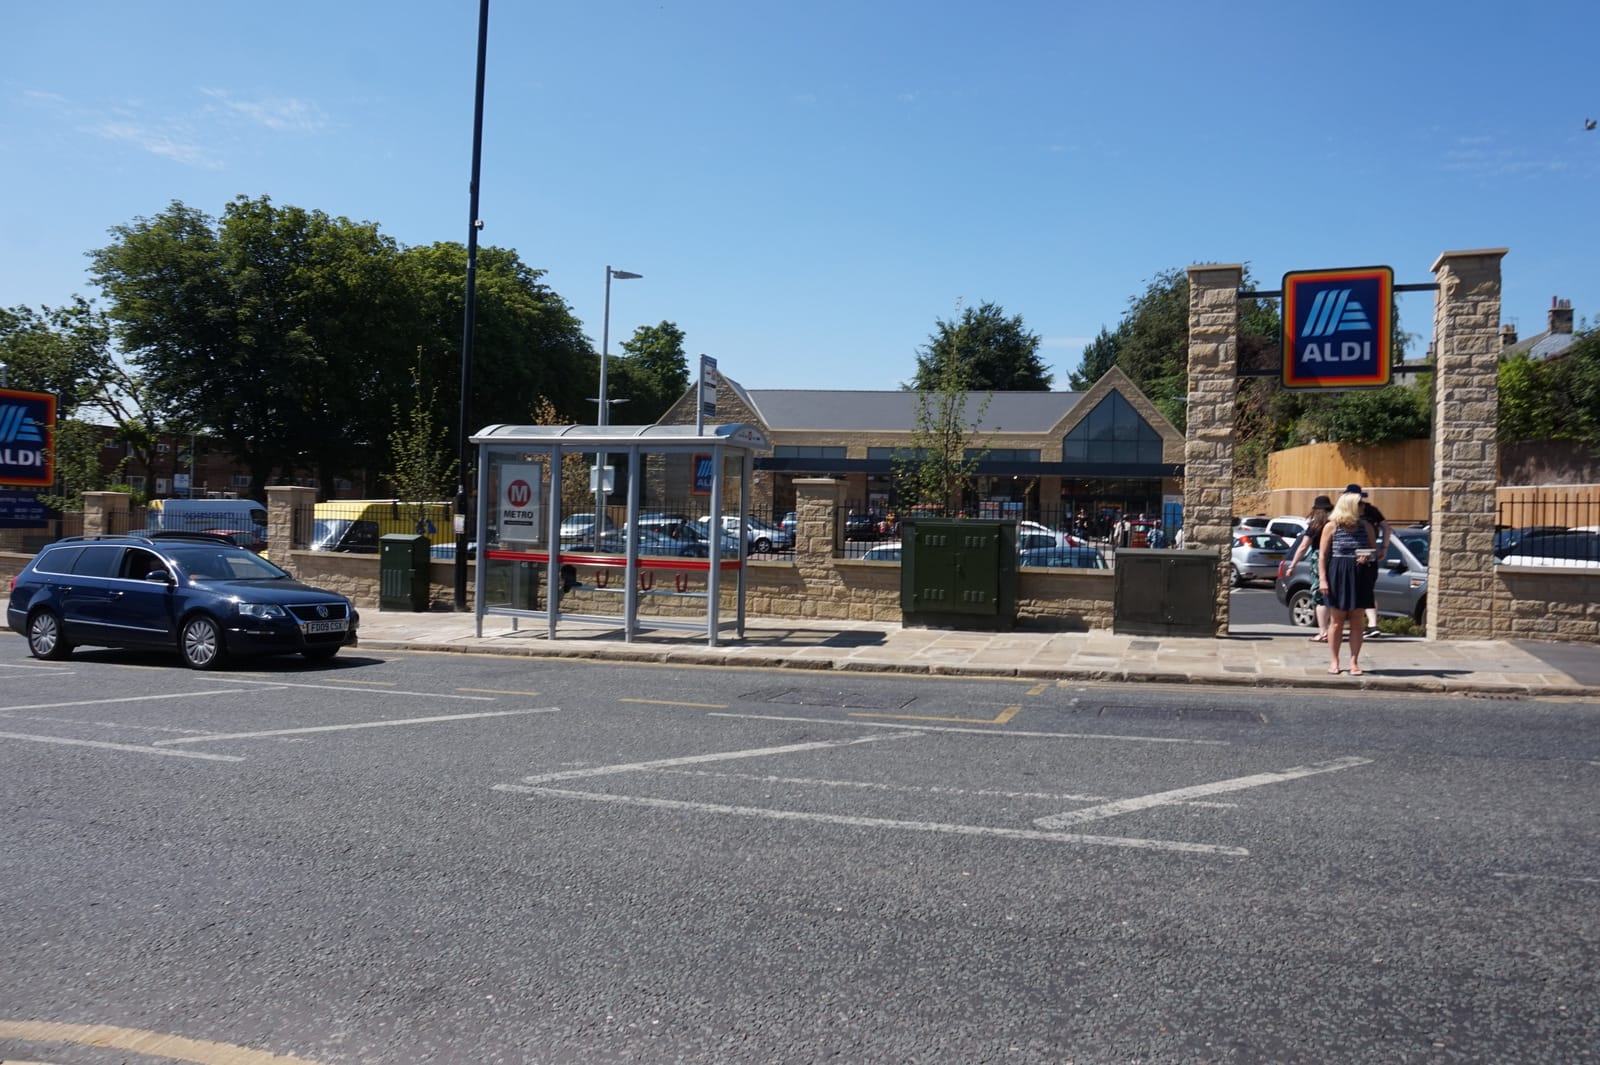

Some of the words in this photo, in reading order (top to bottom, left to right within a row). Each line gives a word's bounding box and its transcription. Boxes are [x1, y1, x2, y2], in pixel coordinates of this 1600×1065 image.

[1301, 341, 1371, 362] ALDI
[0, 448, 42, 466] LDI
[511, 485, 527, 502] M
[503, 510, 534, 519] METRO
